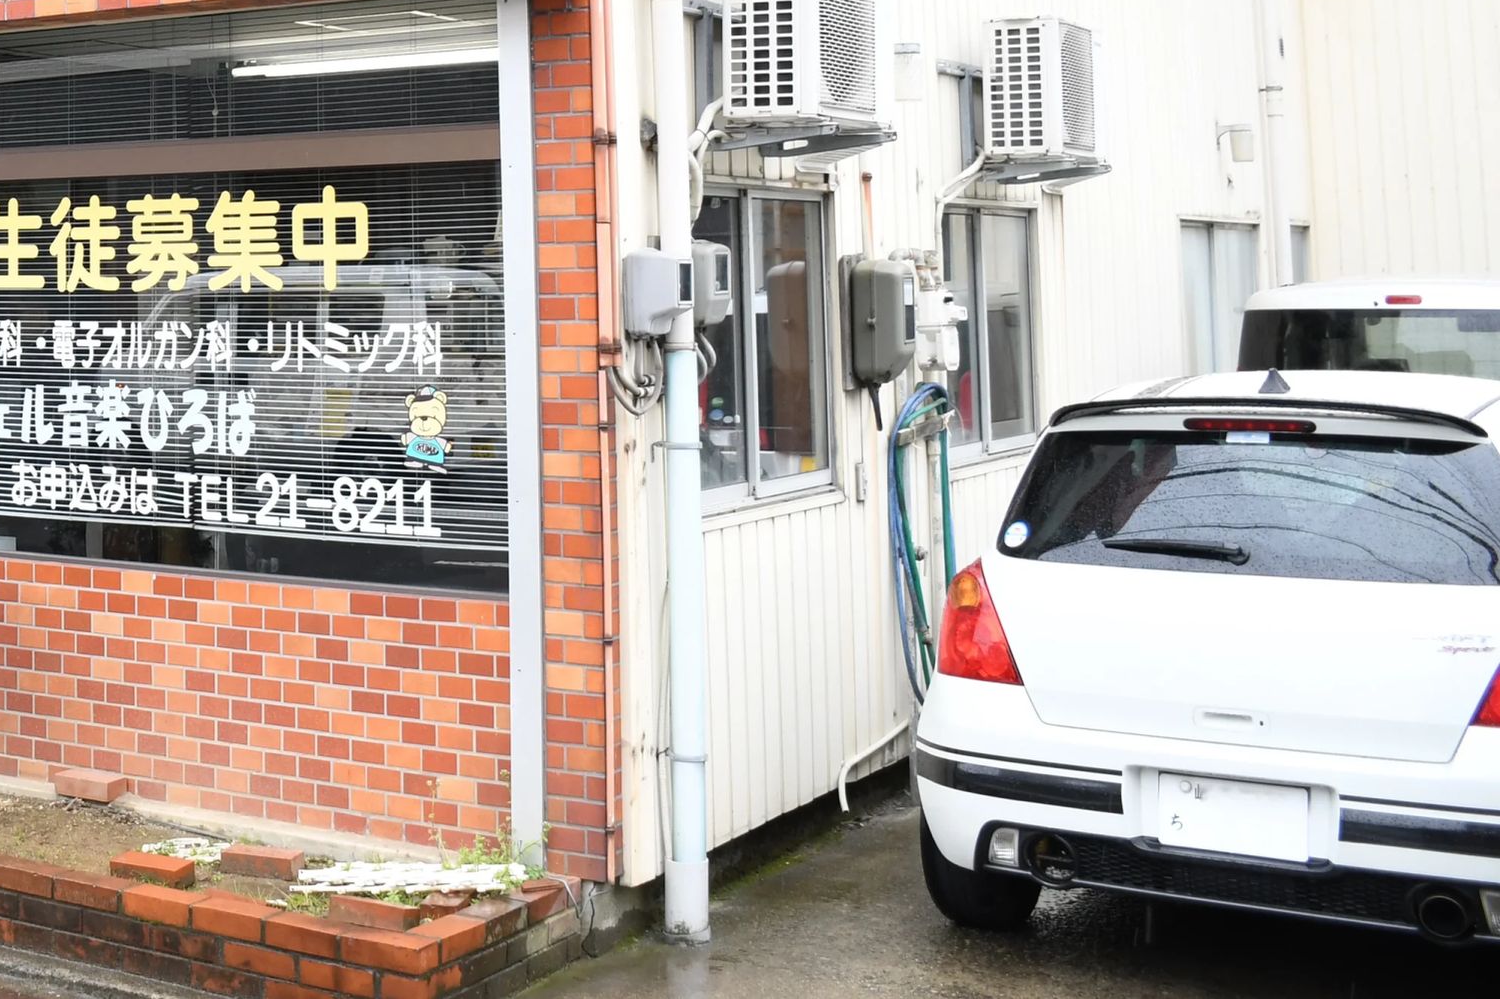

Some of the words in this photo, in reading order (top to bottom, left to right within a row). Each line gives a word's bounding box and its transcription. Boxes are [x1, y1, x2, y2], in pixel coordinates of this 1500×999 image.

[11, 460, 158, 515] お申込みは
[174, 472, 249, 523] TEL
[255, 472, 442, 537] 21-8211
[1170, 813, 1183, 831] ち
